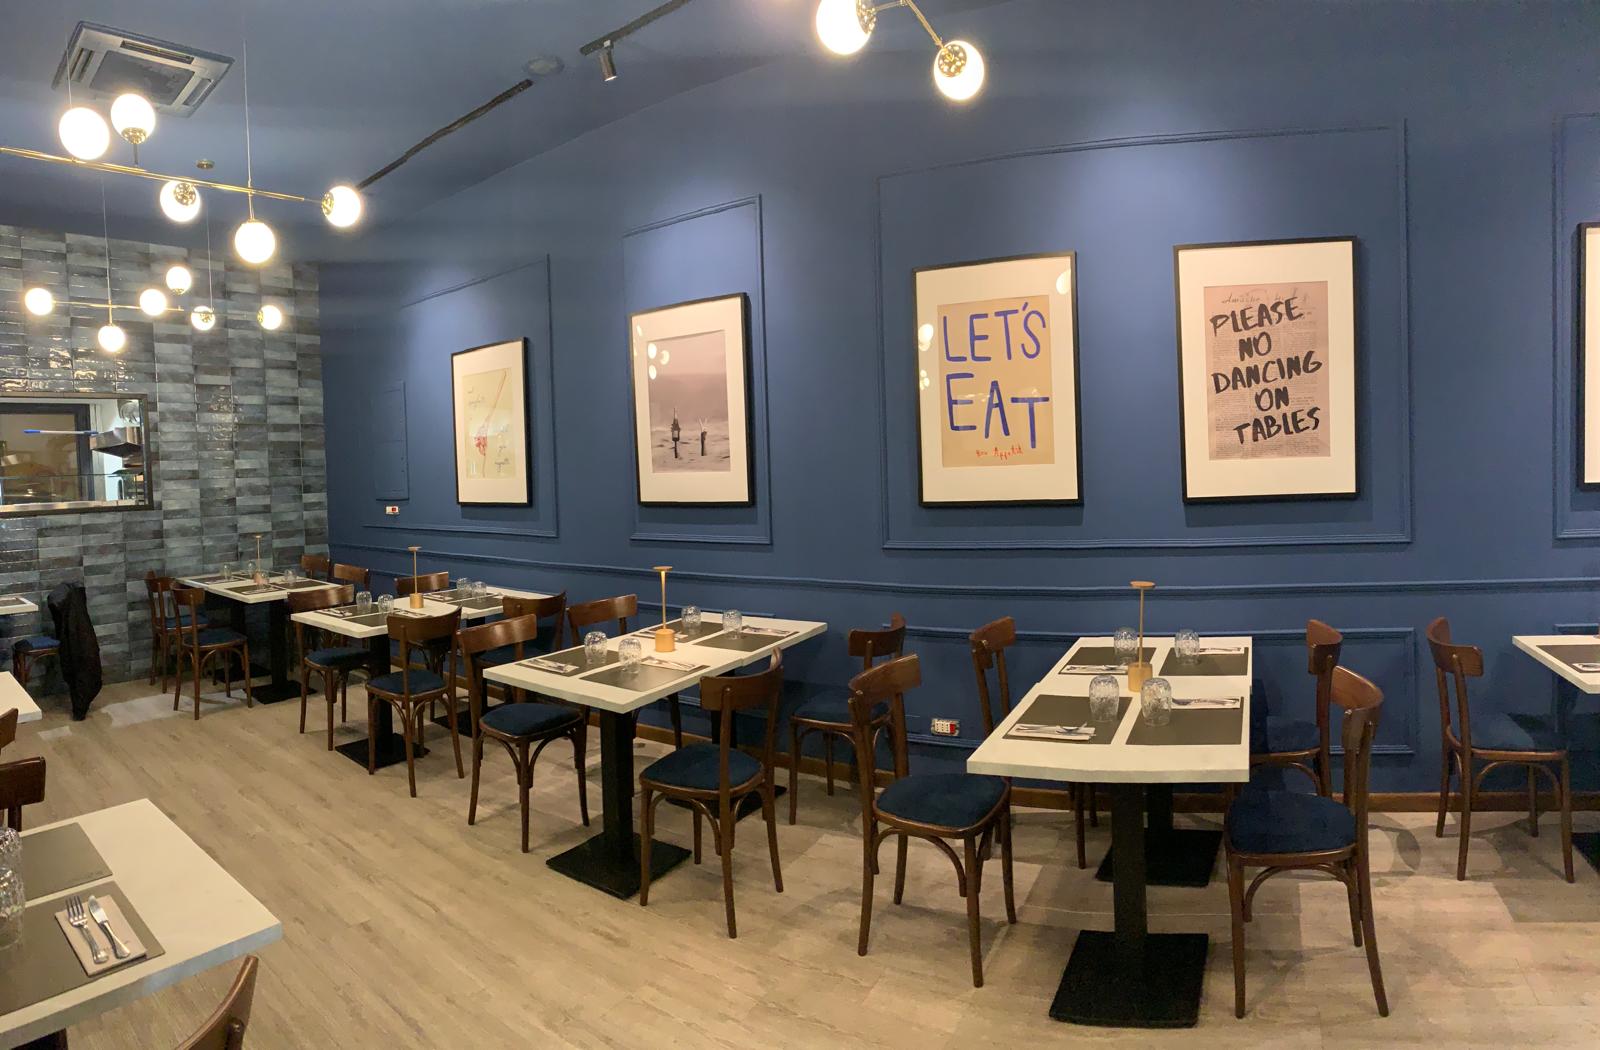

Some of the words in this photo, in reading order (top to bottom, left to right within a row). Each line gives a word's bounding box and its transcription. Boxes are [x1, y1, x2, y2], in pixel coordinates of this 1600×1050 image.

[943, 302, 1046, 362] LET'S
[1209, 296, 1303, 337] PLEASE
[1239, 331, 1272, 361] NO
[1211, 350, 1323, 394] DANCING
[946, 372, 1050, 449] EAT
[1255, 386, 1289, 412] ON
[1233, 406, 1320, 445] TABLES
